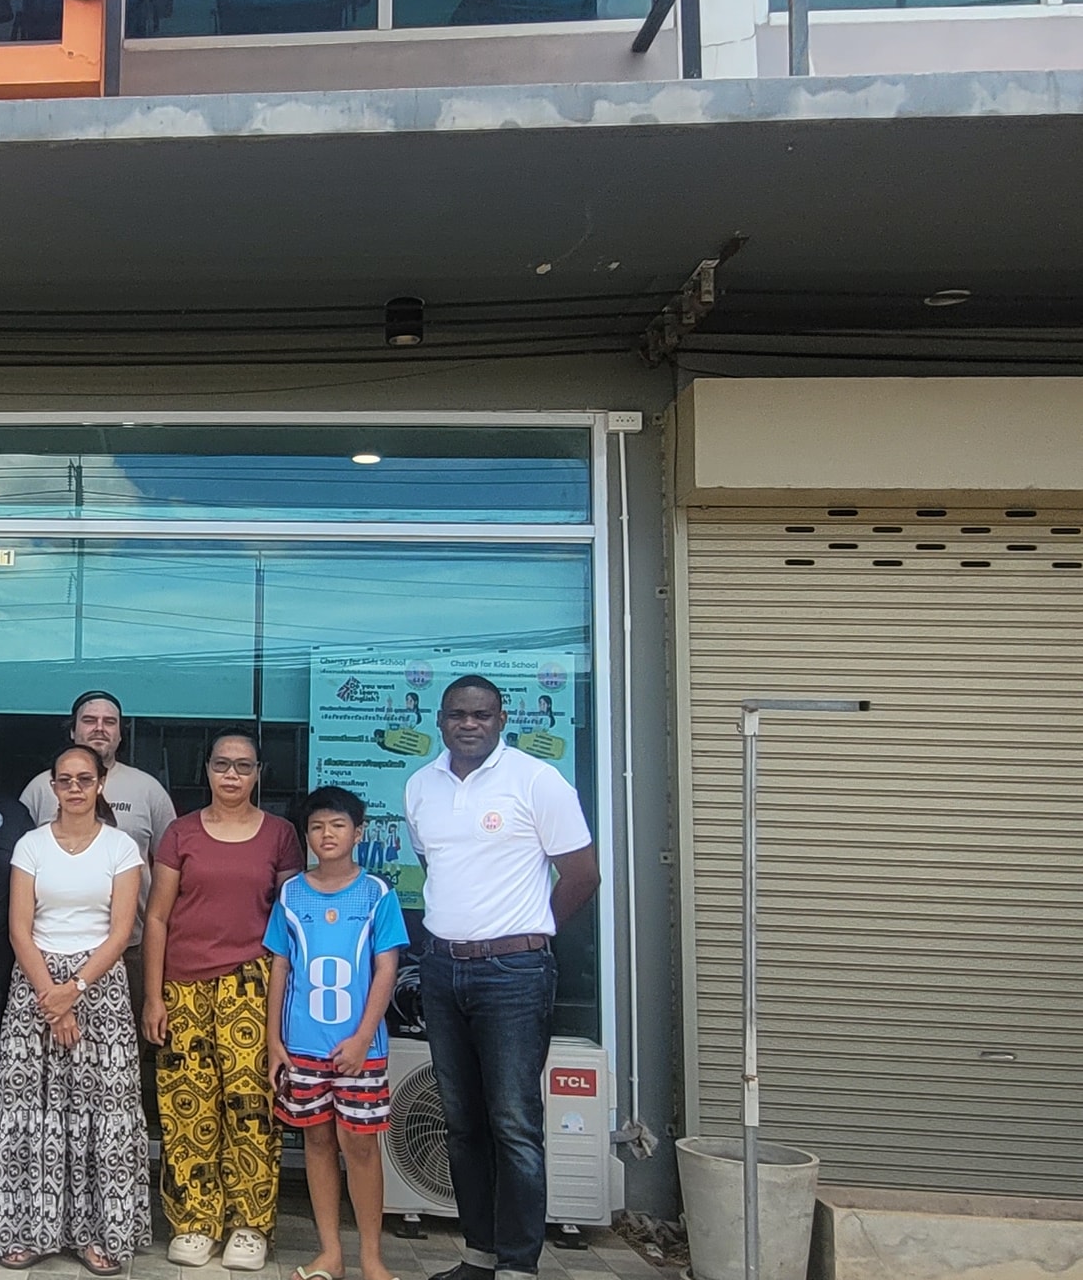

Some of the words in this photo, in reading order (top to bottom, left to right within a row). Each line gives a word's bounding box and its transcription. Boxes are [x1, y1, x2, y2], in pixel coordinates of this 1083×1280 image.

[450, 660, 478, 669] Charity
[480, 660, 492, 668] for
[493, 660, 510, 668] Kids
[511, 661, 538, 669] School
[309, 955, 352, 1025] 8
[555, 1075, 590, 1089] TCL
